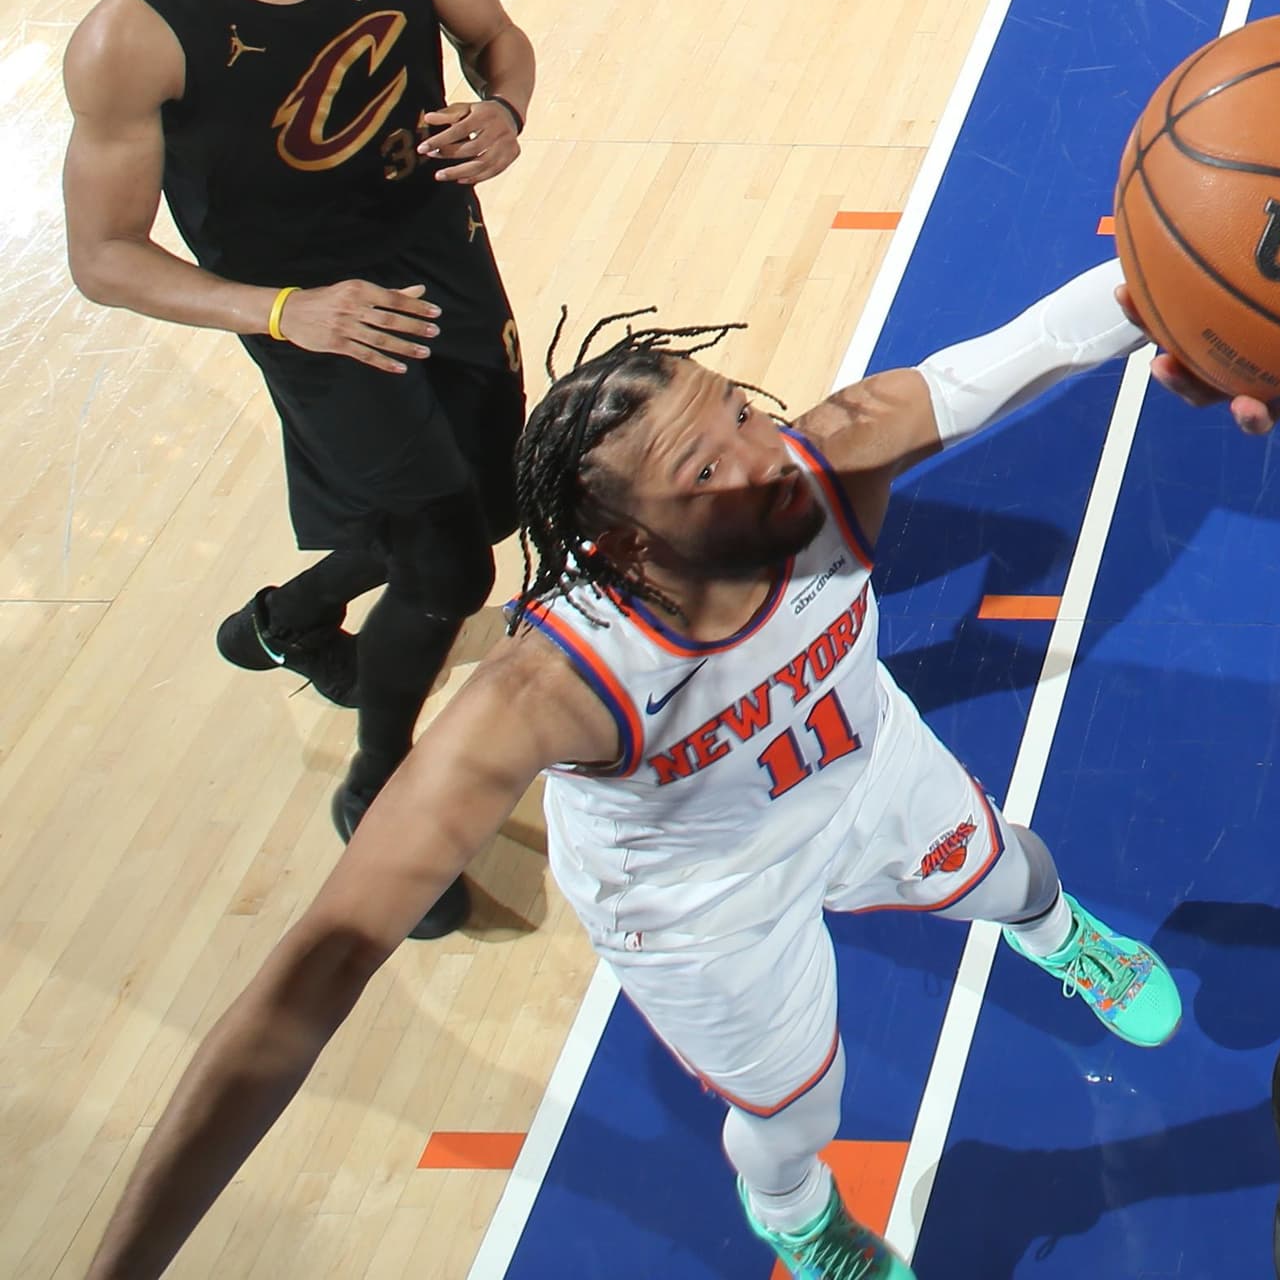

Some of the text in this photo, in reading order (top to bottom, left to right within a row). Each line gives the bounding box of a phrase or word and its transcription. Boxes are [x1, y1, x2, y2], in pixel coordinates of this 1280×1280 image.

[794, 588, 817, 615] abu
[815, 554, 847, 594] dhabi
[646, 680, 773, 787] NEW
[757, 686, 862, 801] 11
